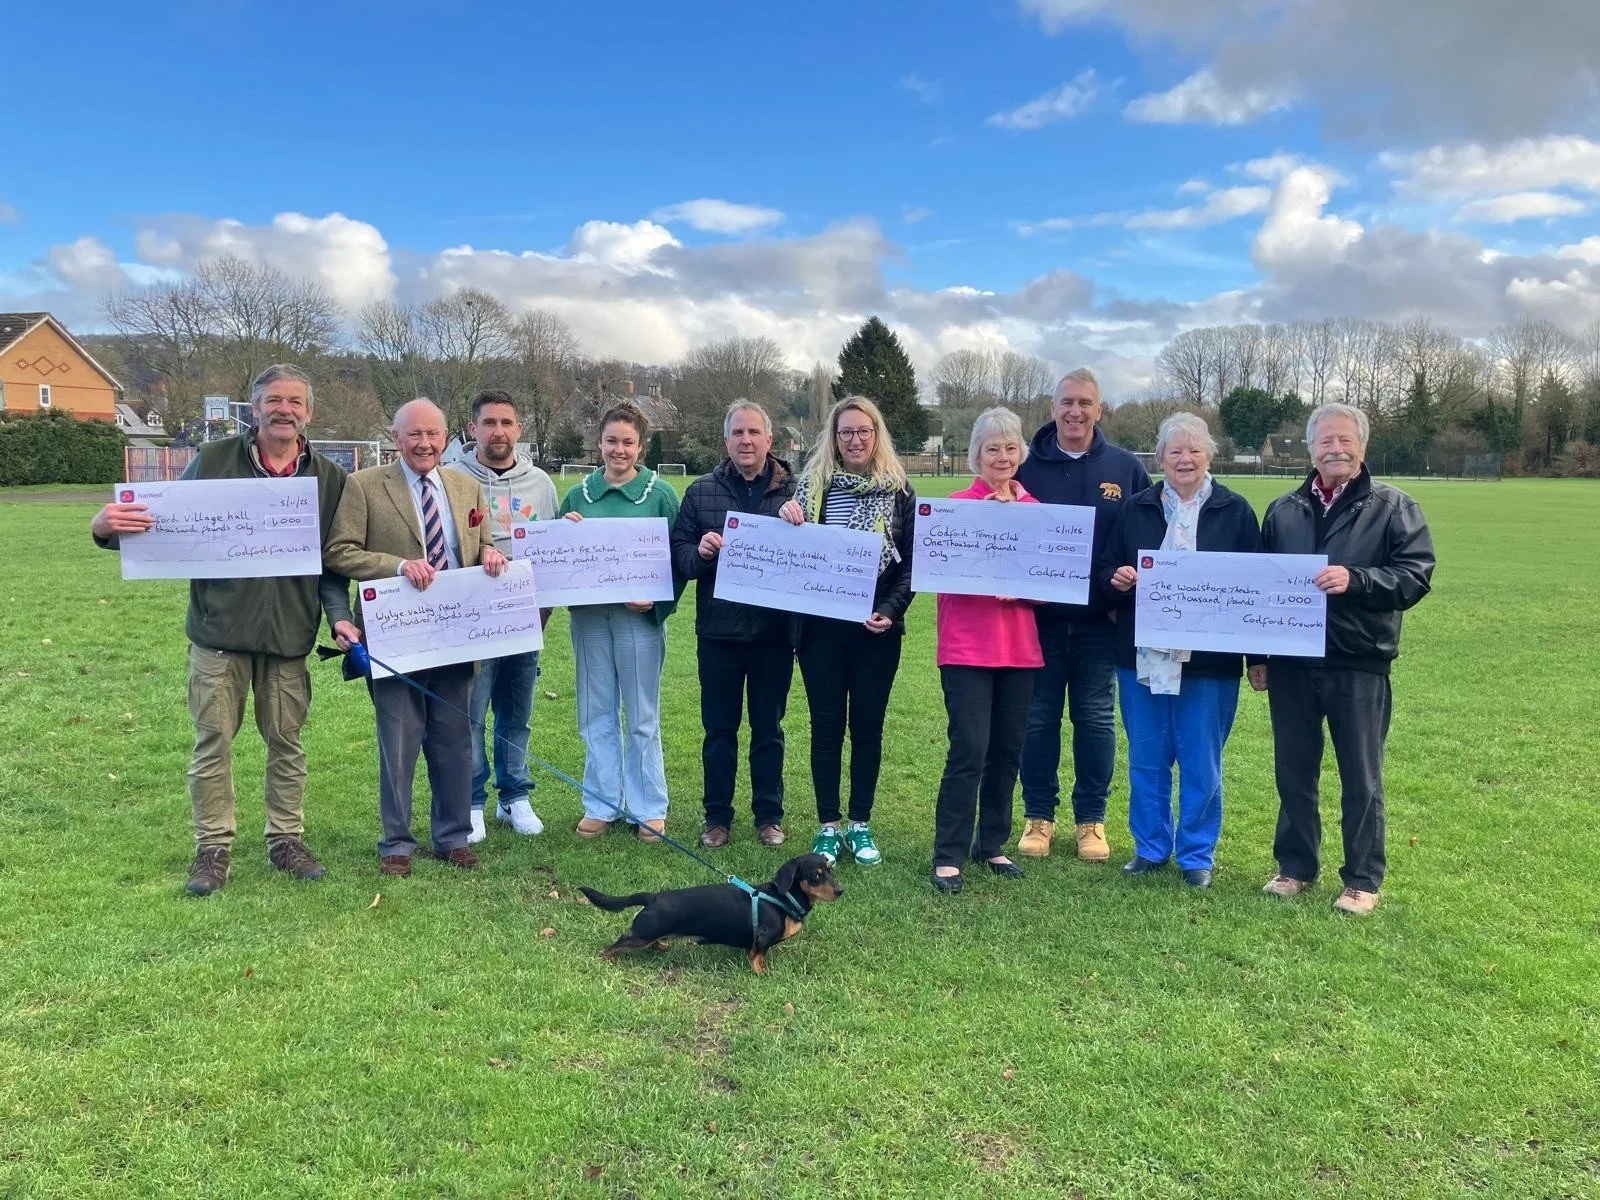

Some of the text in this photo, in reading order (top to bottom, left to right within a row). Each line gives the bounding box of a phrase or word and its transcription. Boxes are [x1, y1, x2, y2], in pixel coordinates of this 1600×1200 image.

[228, 510, 249, 520] hall
[929, 524, 968, 538] Codford
[999, 532, 1019, 542] Club
[922, 537, 942, 547] One
[727, 548, 743, 558] One
[1028, 565, 1065, 578] Codford
[803, 582, 834, 593] Codford
[1151, 581, 1172, 591] The
[1149, 591, 1171, 601] One
[1242, 613, 1285, 628] Codford
[468, 625, 503, 640] Codford
